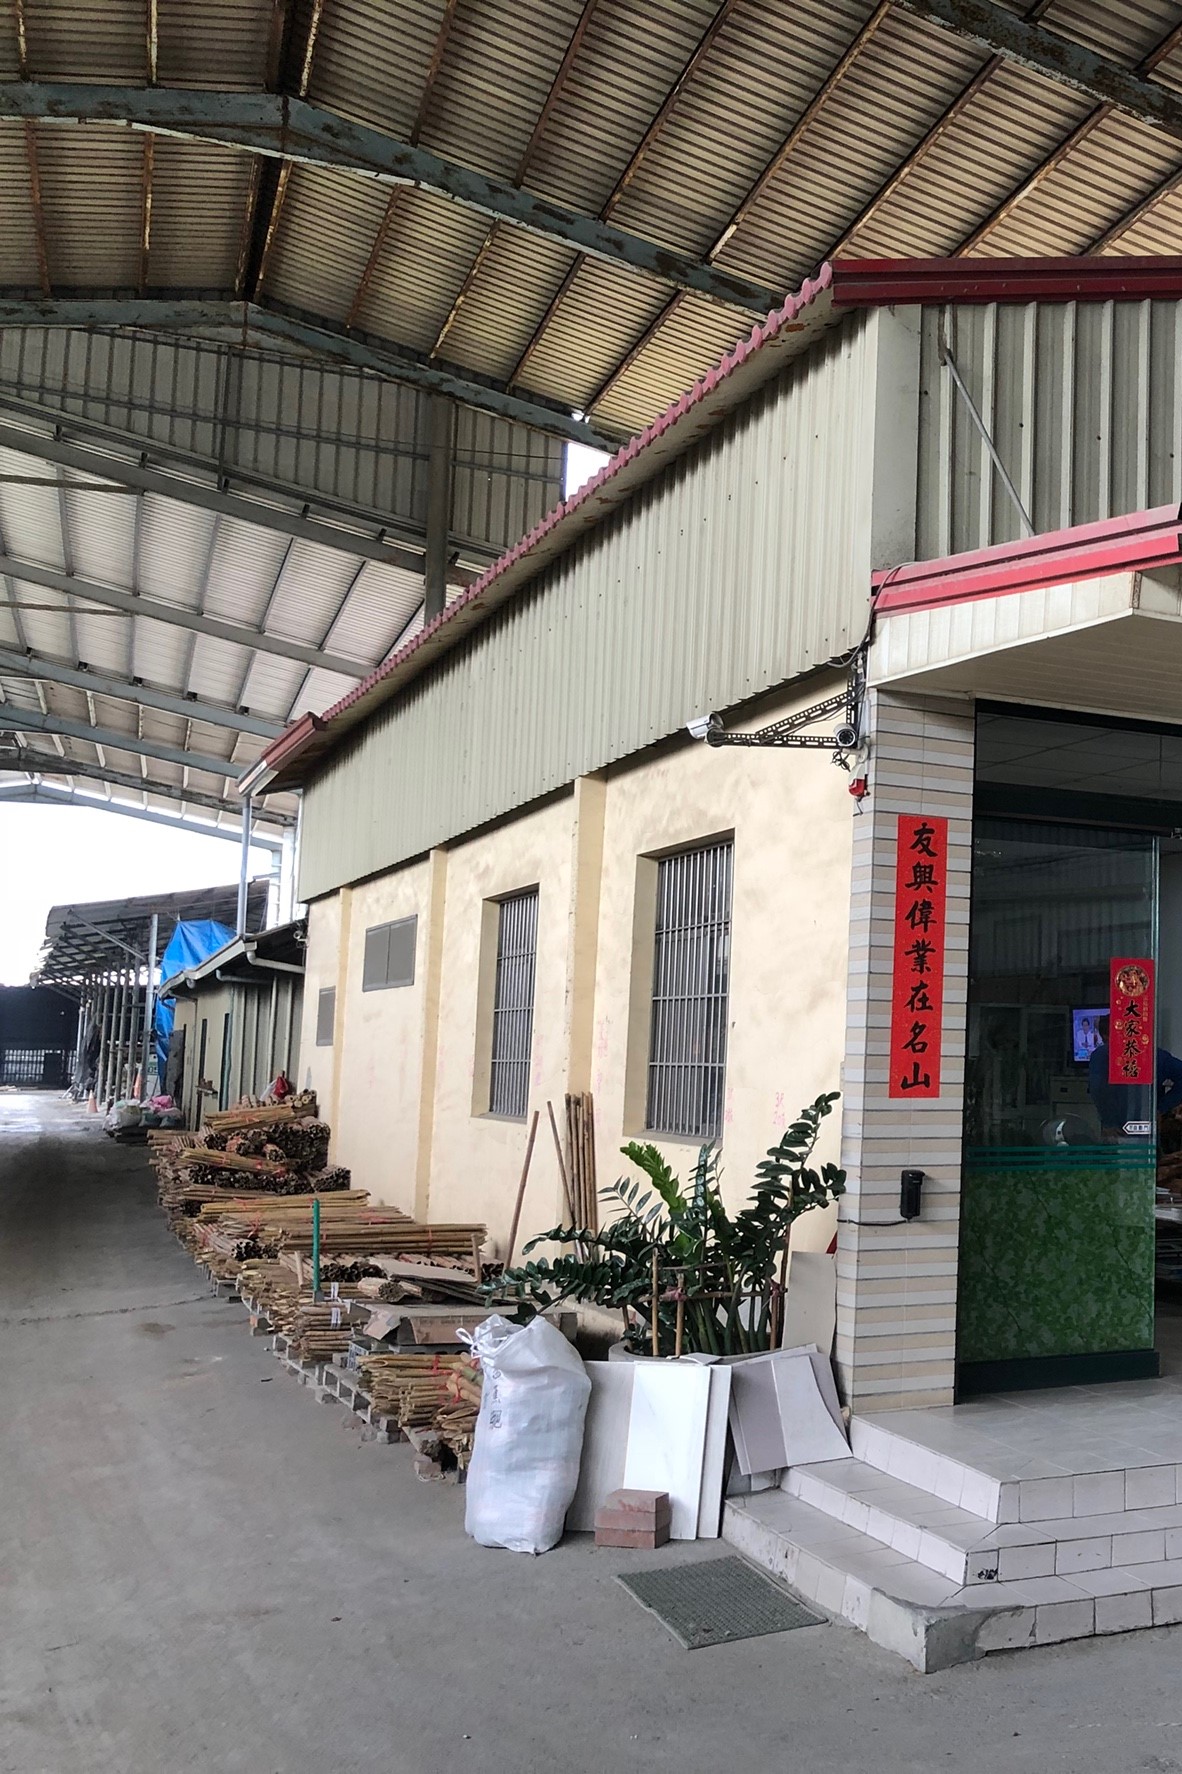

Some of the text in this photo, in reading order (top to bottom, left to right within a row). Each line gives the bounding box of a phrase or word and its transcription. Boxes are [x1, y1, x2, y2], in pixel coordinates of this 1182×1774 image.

[900, 822, 938, 1091] 友興偉業在名山
